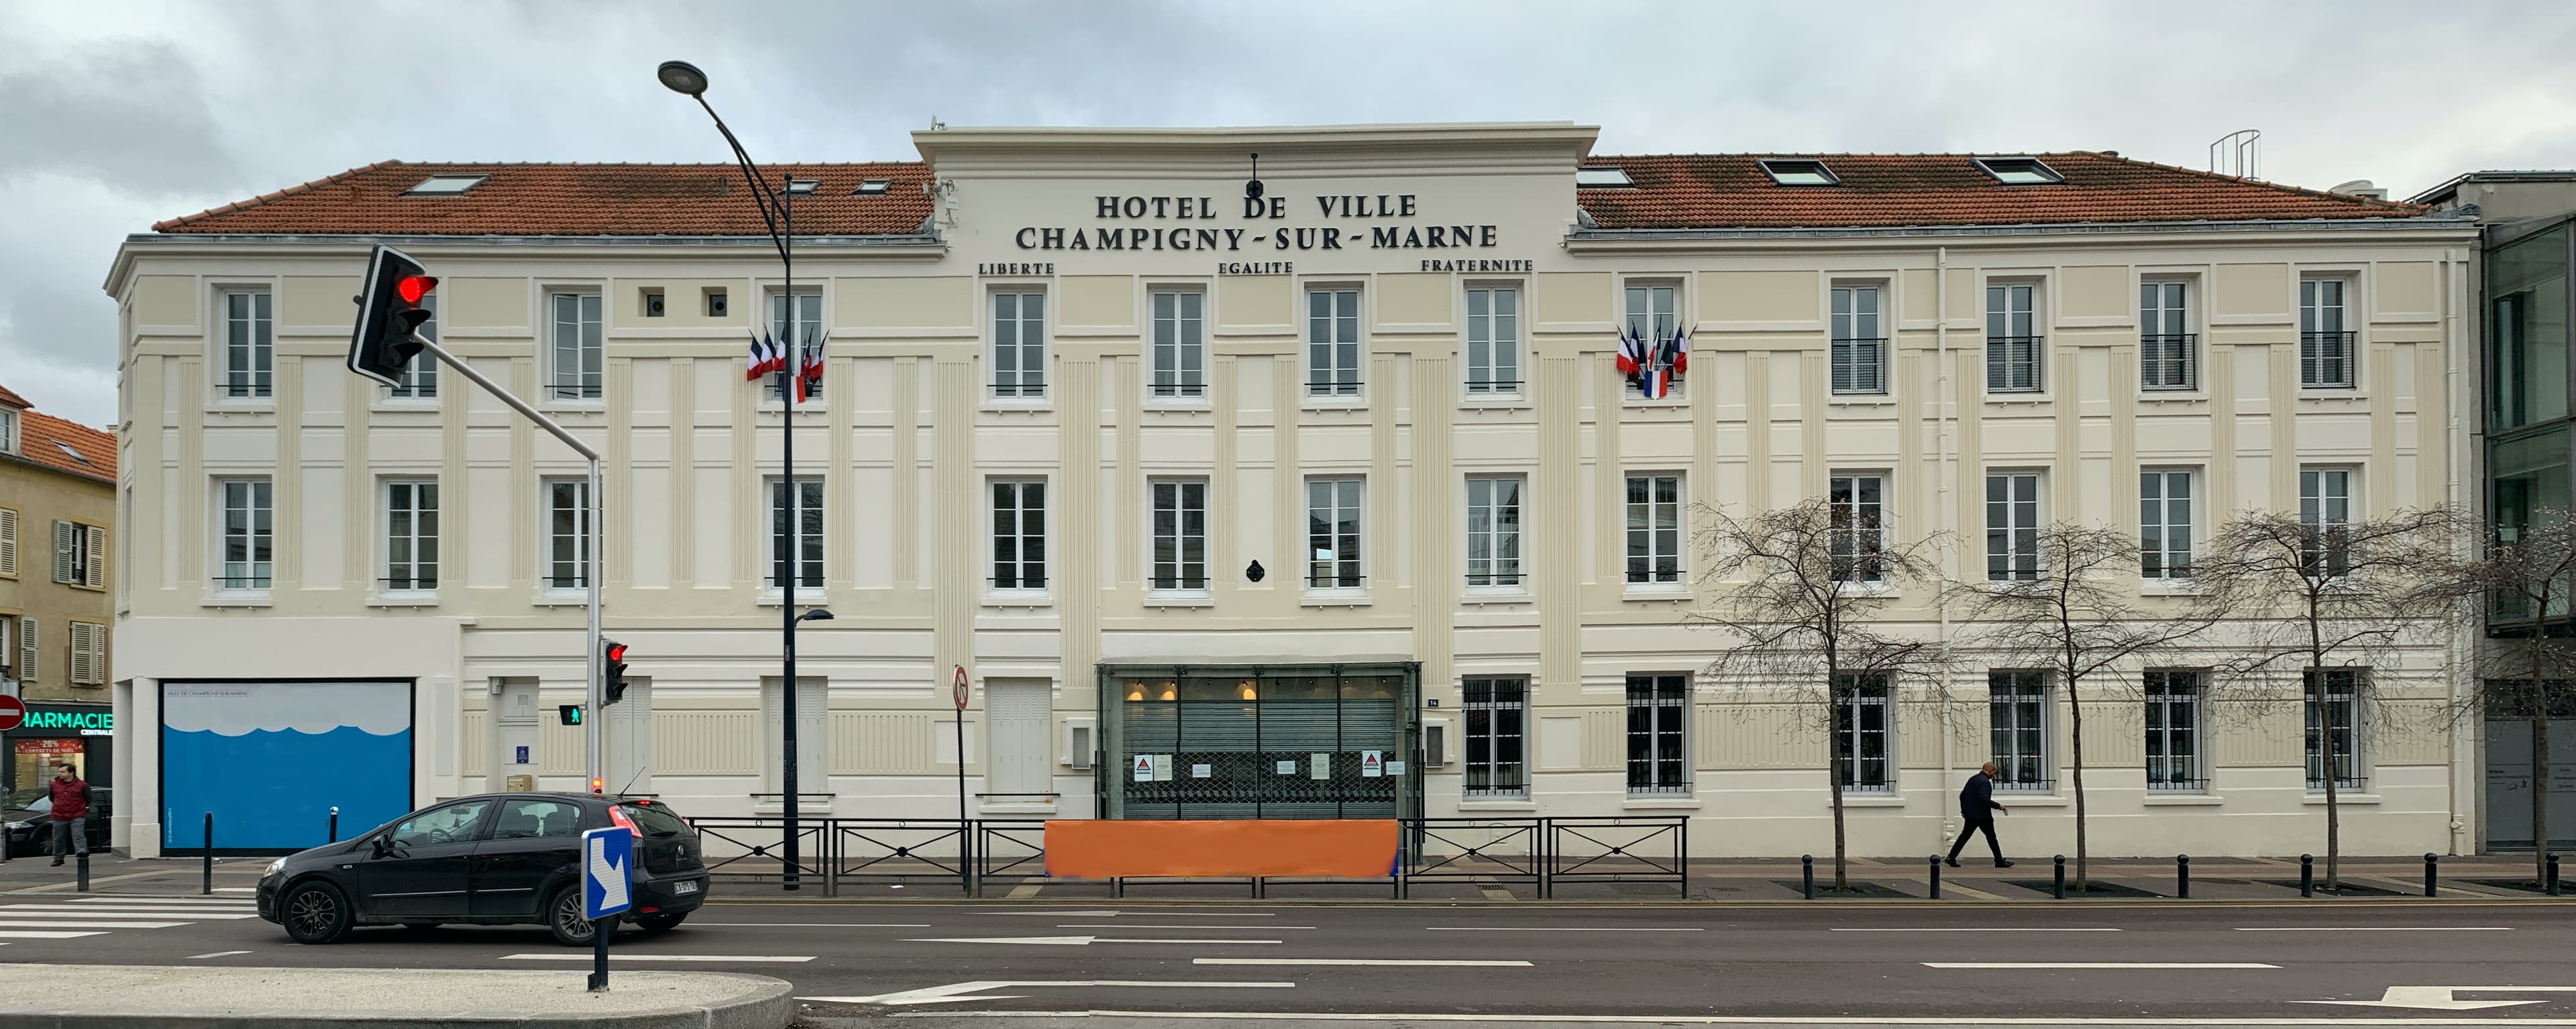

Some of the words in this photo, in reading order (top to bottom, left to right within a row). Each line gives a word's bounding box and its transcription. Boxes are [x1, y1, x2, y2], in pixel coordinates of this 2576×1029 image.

[1095, 196, 1217, 219] HOTEL
[1242, 197, 1286, 220] DE
[1316, 195, 1416, 219] VILLE
[978, 263, 1055, 275] LIBERTE
[1218, 262, 1293, 274] EGALITE
[1421, 260, 1534, 272] FRATERNITE
[22, 711, 113, 728] HARMACIE
